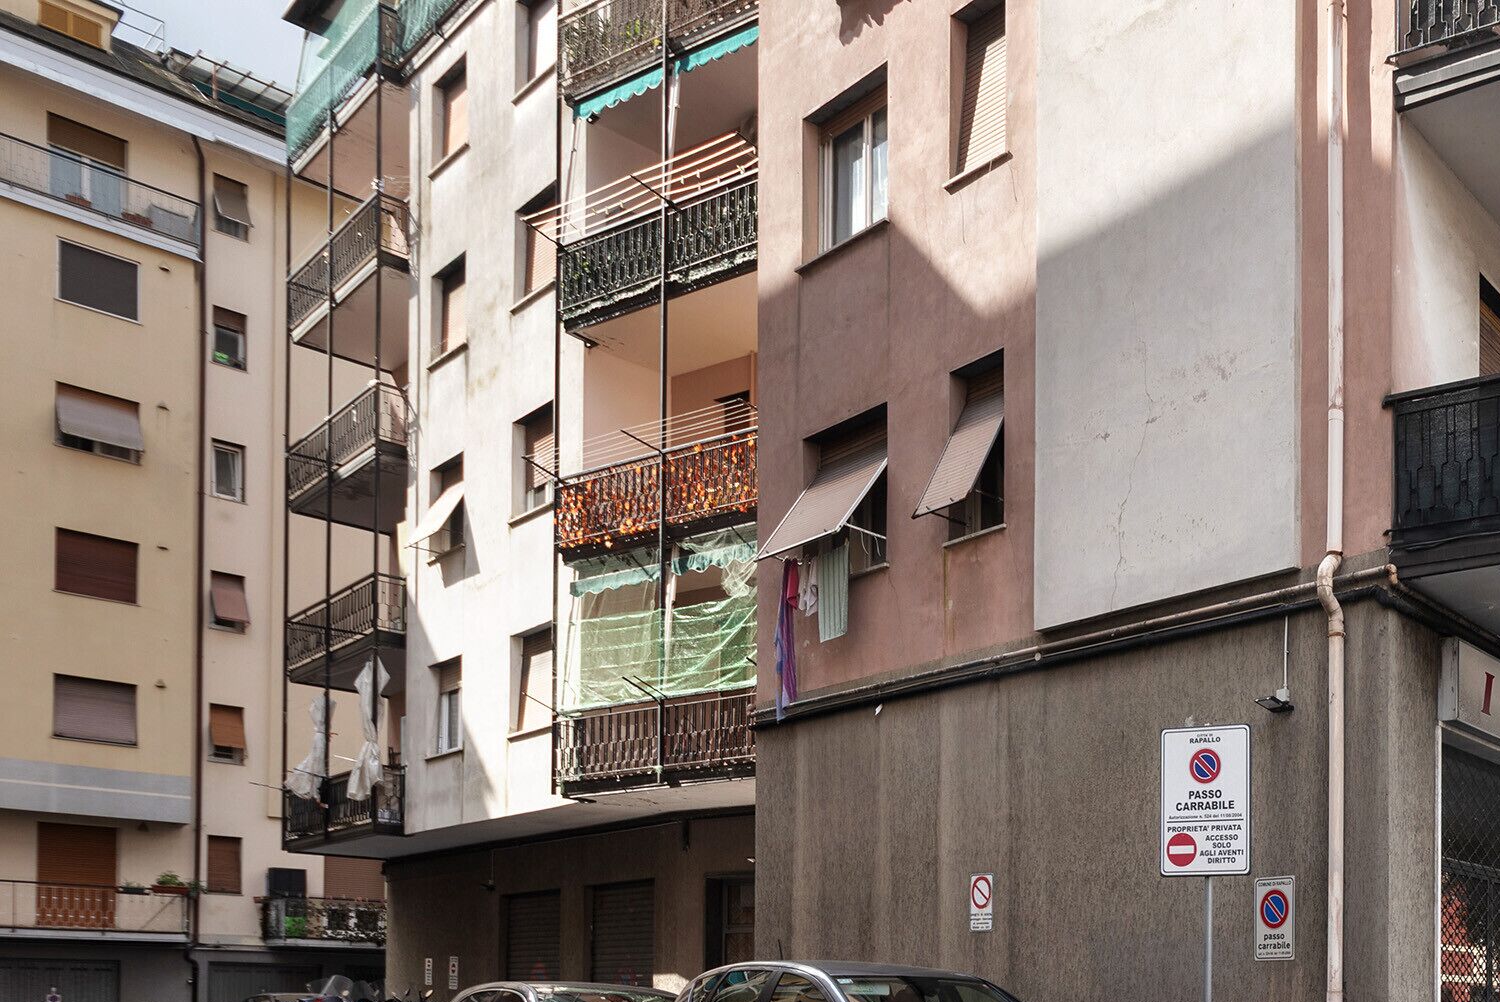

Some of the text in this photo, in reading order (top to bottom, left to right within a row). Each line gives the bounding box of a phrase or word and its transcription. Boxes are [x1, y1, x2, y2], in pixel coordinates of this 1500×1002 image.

[1481, 671, 1494, 716] I
[1189, 736, 1221, 744] RAPALLO
[1188, 789, 1222, 799] PASSO
[1175, 800, 1235, 811] CARRABILE
[1263, 933, 1285, 941] passo
[1258, 941, 1291, 950] carrabile
